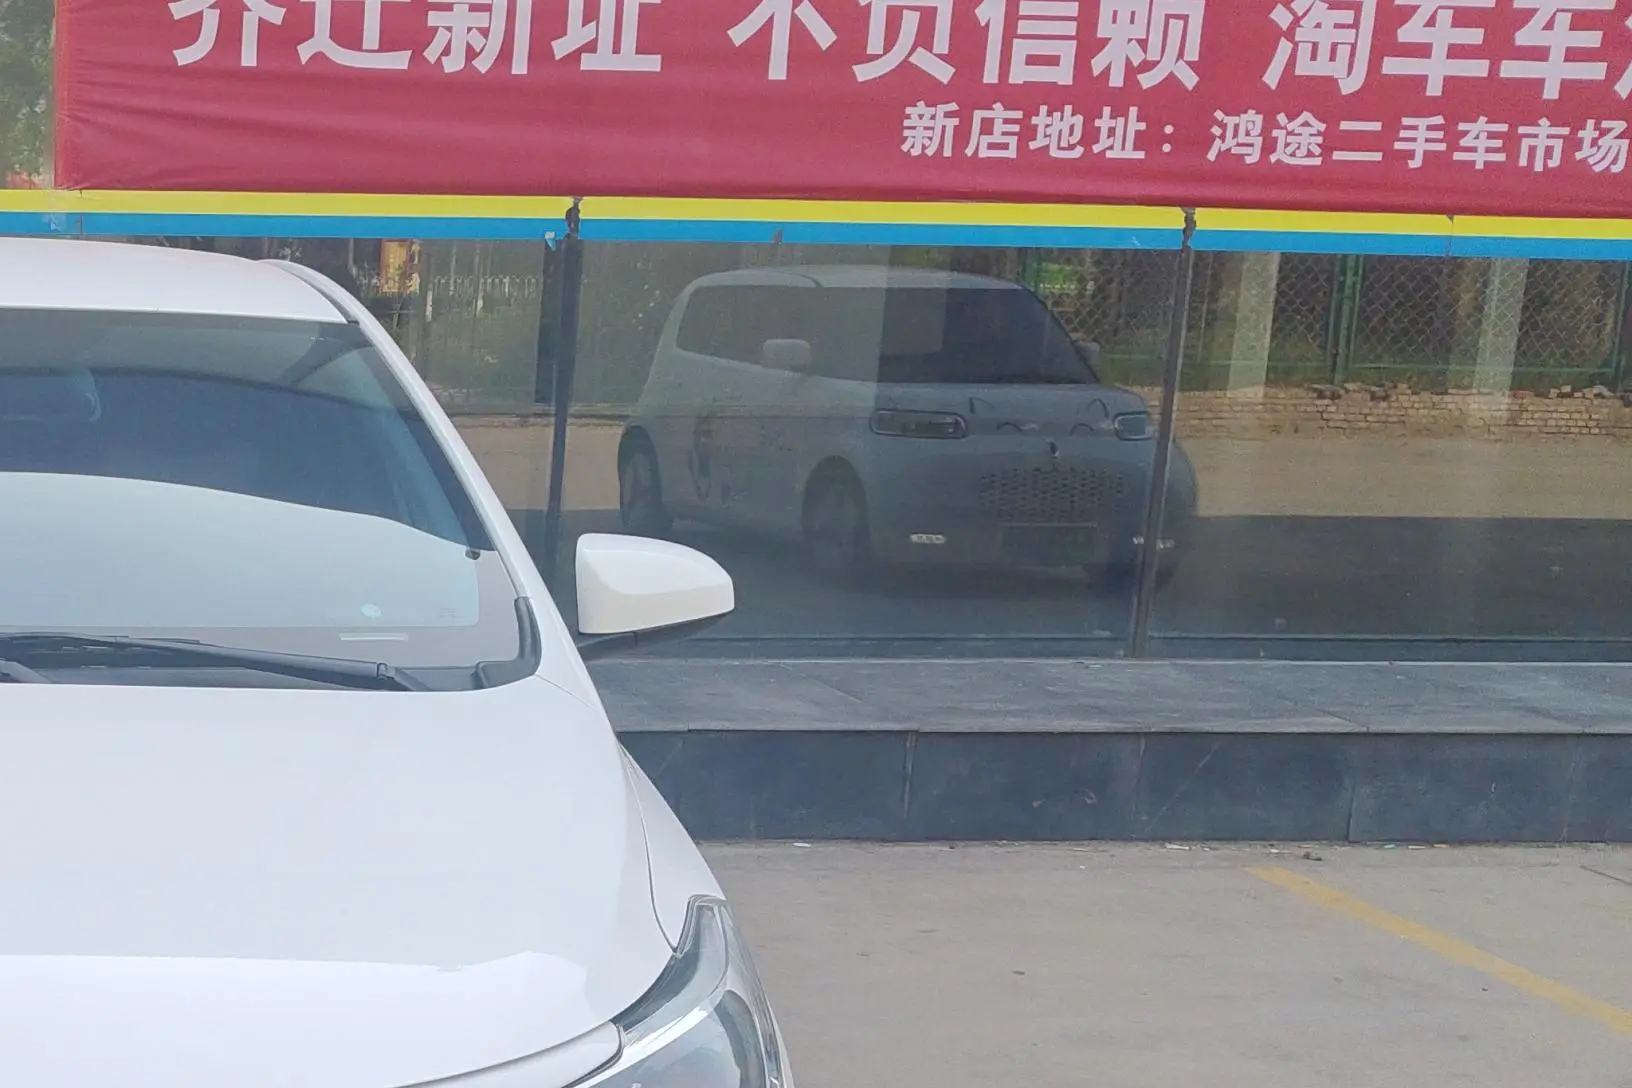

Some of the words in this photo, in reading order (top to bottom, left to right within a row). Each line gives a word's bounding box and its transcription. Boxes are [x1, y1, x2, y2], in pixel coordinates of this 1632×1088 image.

[726, 0, 1206, 91] 不负信赖
[1262, 0, 1632, 100] 淘车车
[900, 99, 1631, 174] 新店地址：鸿途二手车市场
